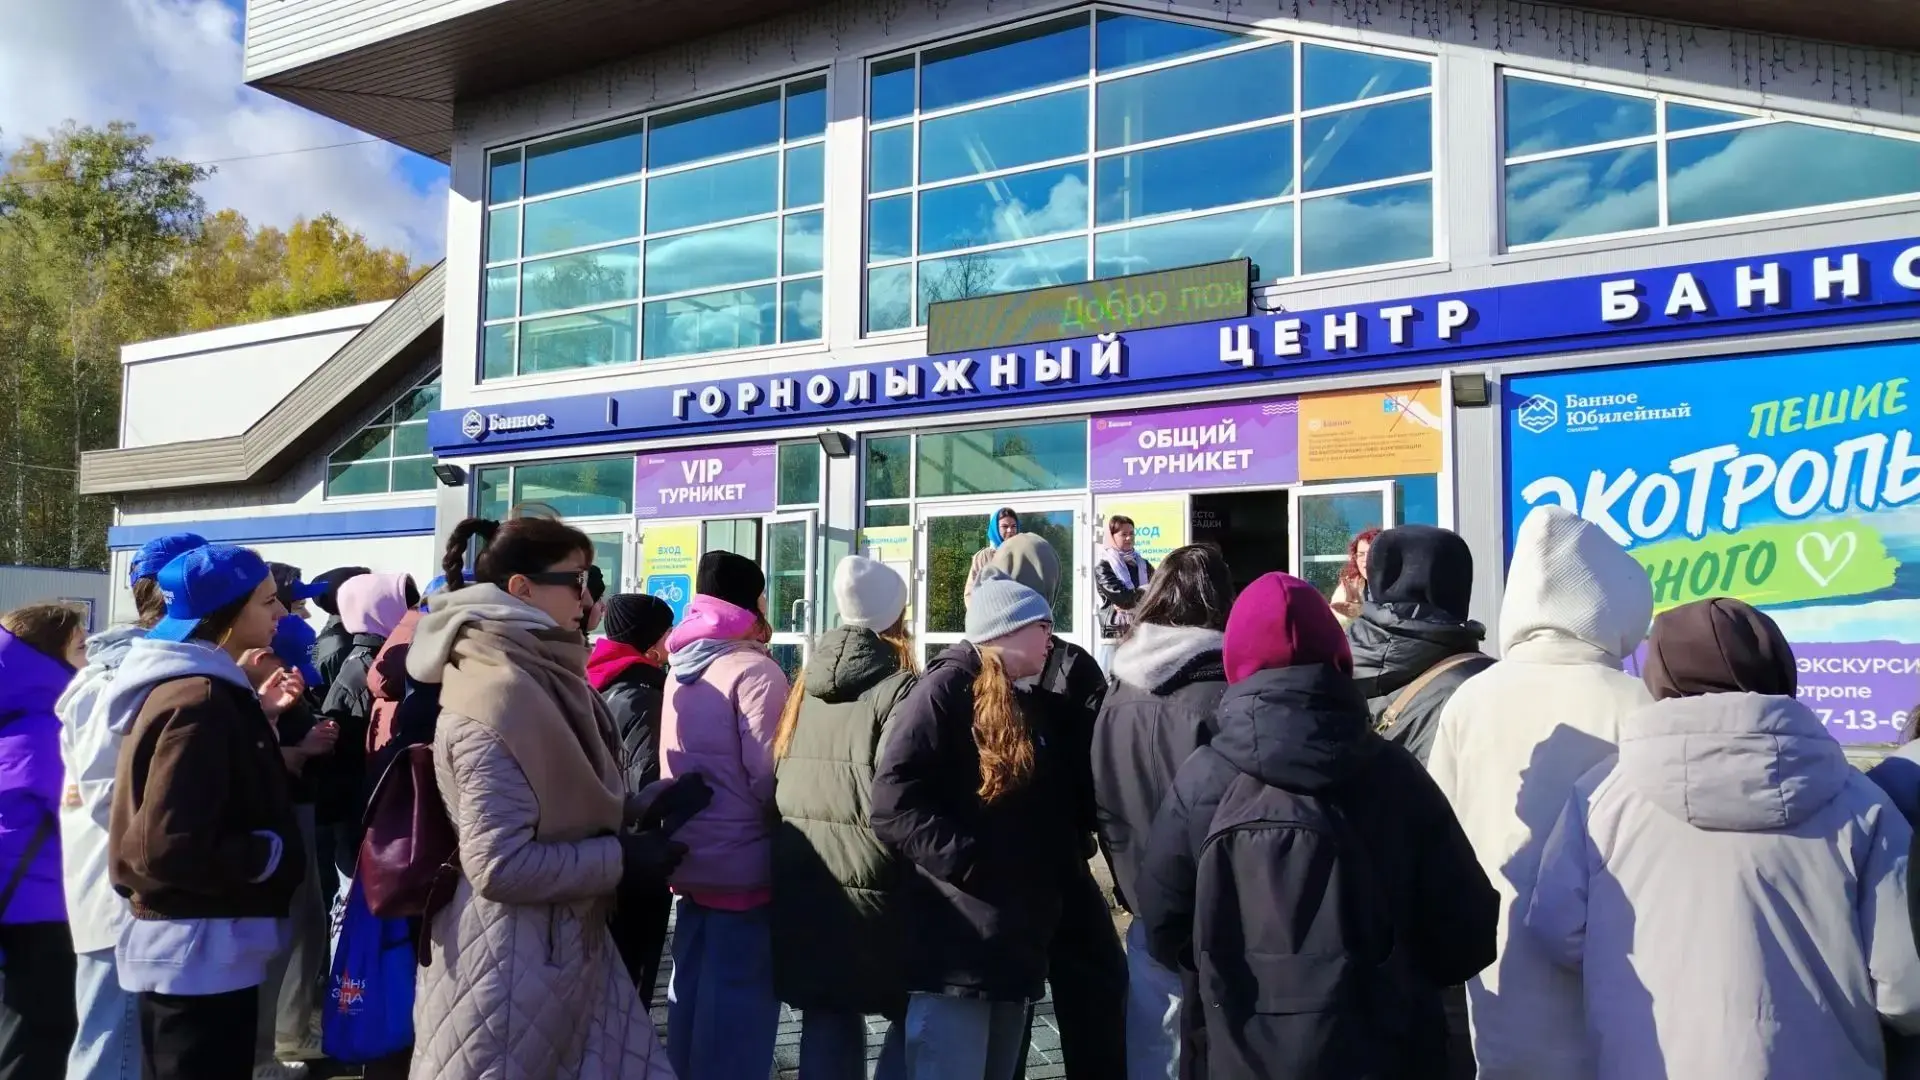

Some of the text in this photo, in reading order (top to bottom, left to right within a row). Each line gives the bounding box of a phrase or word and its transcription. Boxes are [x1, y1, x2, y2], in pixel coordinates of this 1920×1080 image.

[1059, 288, 1167, 335] Добро
[672, 244, 1920, 418] ГОРНОЛЫЖНЫЙ ЦЕНТР БАННО
[1565, 392, 1638, 409] Банное
[1747, 377, 1909, 439] ПЕШИЕ
[488, 413, 548, 431] Банное
[1566, 402, 1692, 426] Юбилейный
[1138, 418, 1237, 450] ОБЩИЙ
[681, 458, 723, 484] VIP
[1123, 449, 1253, 476] ТУРНИКЕТ
[658, 483, 746, 504] ТУРНИКЕТ
[657, 545, 681, 555] ВХОД
